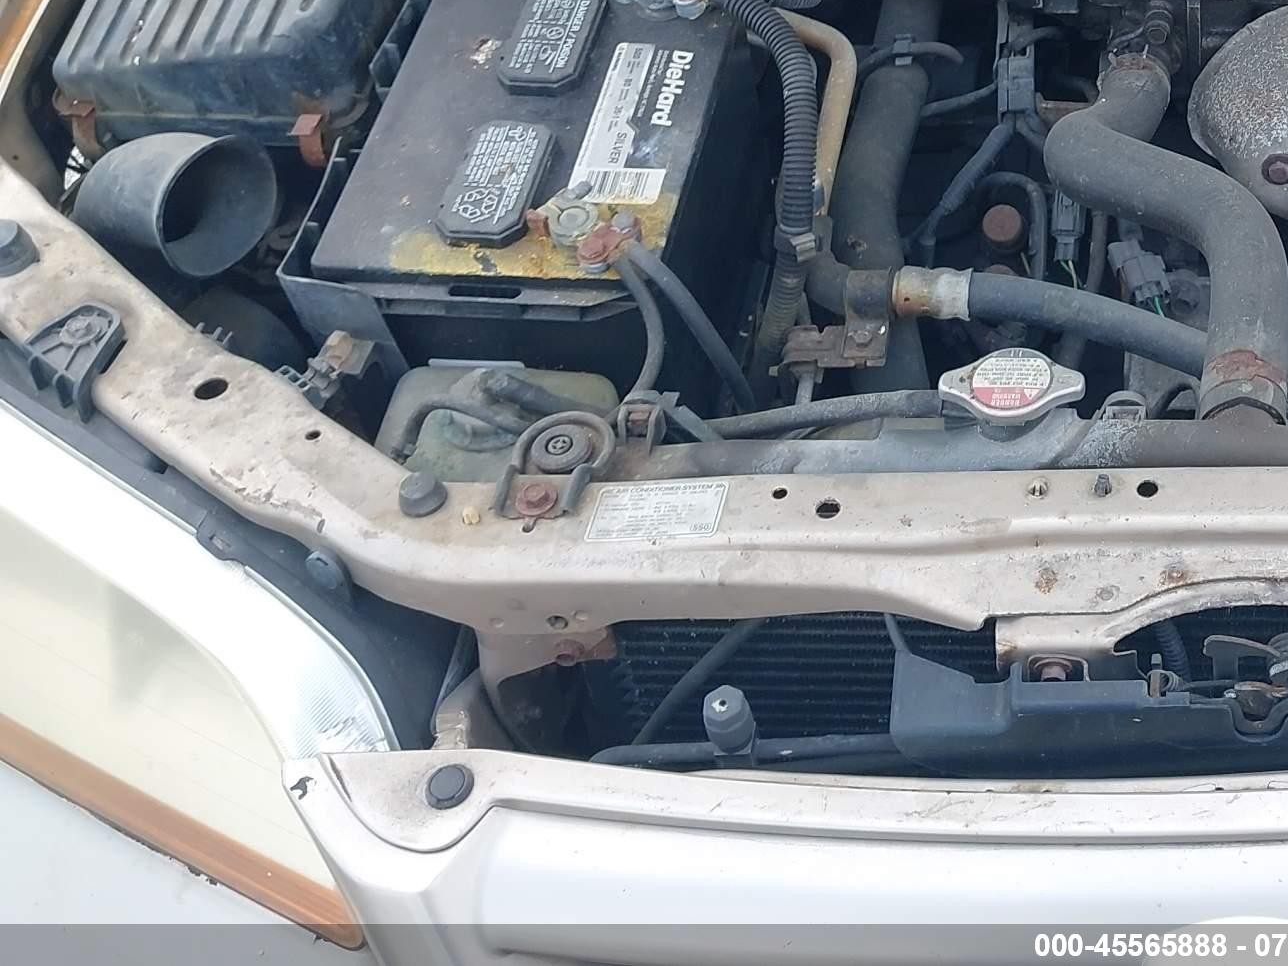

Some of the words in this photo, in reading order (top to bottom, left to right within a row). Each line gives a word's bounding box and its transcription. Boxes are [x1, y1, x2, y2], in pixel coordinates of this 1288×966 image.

[570, 0, 591, 32] DANGER
[555, 38, 576, 68] POISON
[650, 50, 695, 127] DieHard
[607, 132, 628, 164] SILVER
[682, 483, 714, 491] SYSTEM
